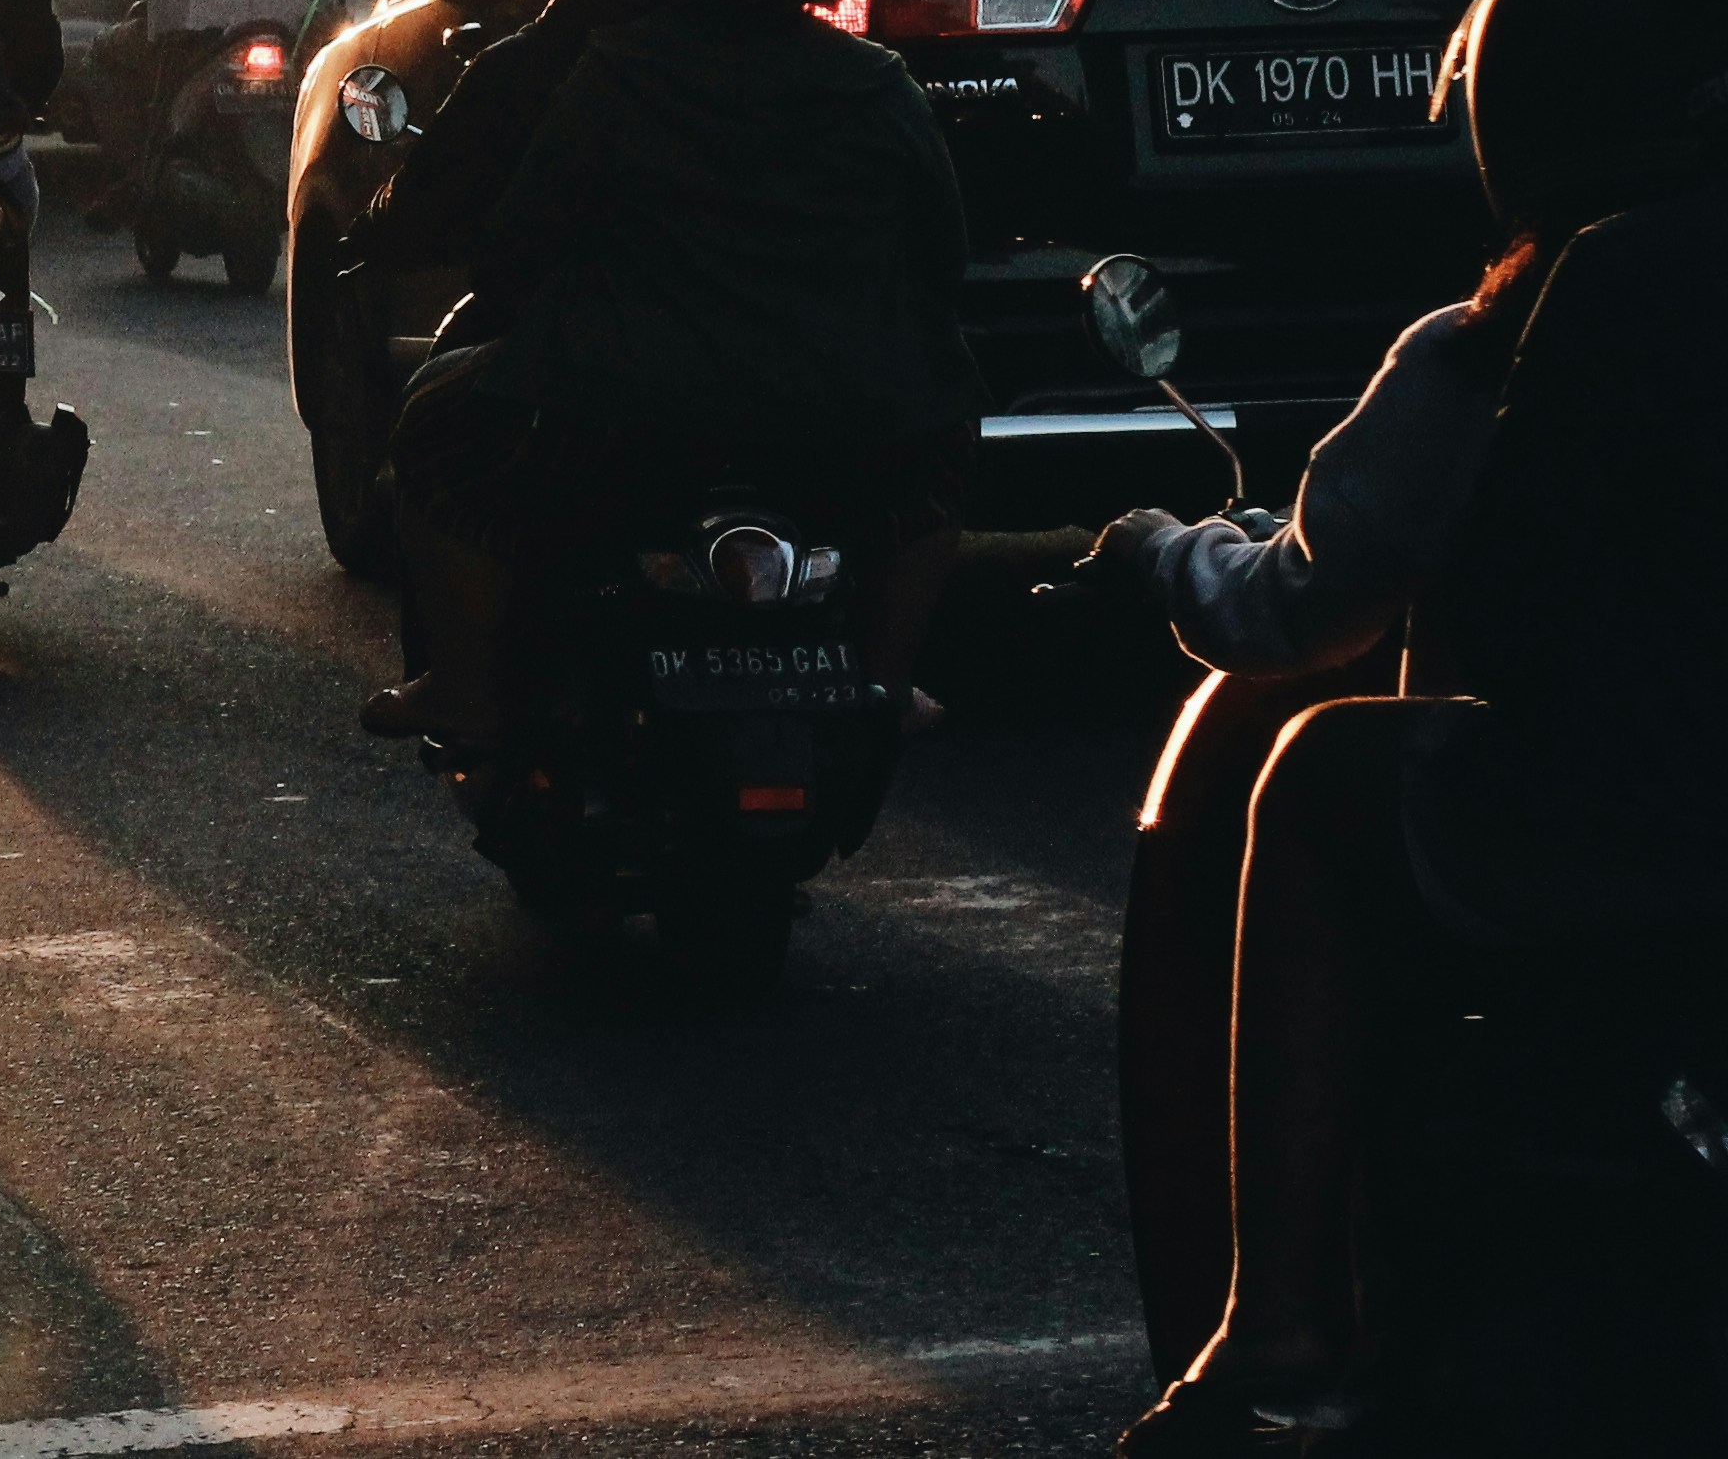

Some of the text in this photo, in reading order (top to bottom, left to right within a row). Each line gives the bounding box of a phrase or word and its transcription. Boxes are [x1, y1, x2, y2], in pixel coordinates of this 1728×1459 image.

[1172, 52, 1435, 107] DK 1970 HH
[1271, 109, 1342, 126] 05 24
[649, 649, 690, 678] DK
[706, 646, 784, 675] 5365
